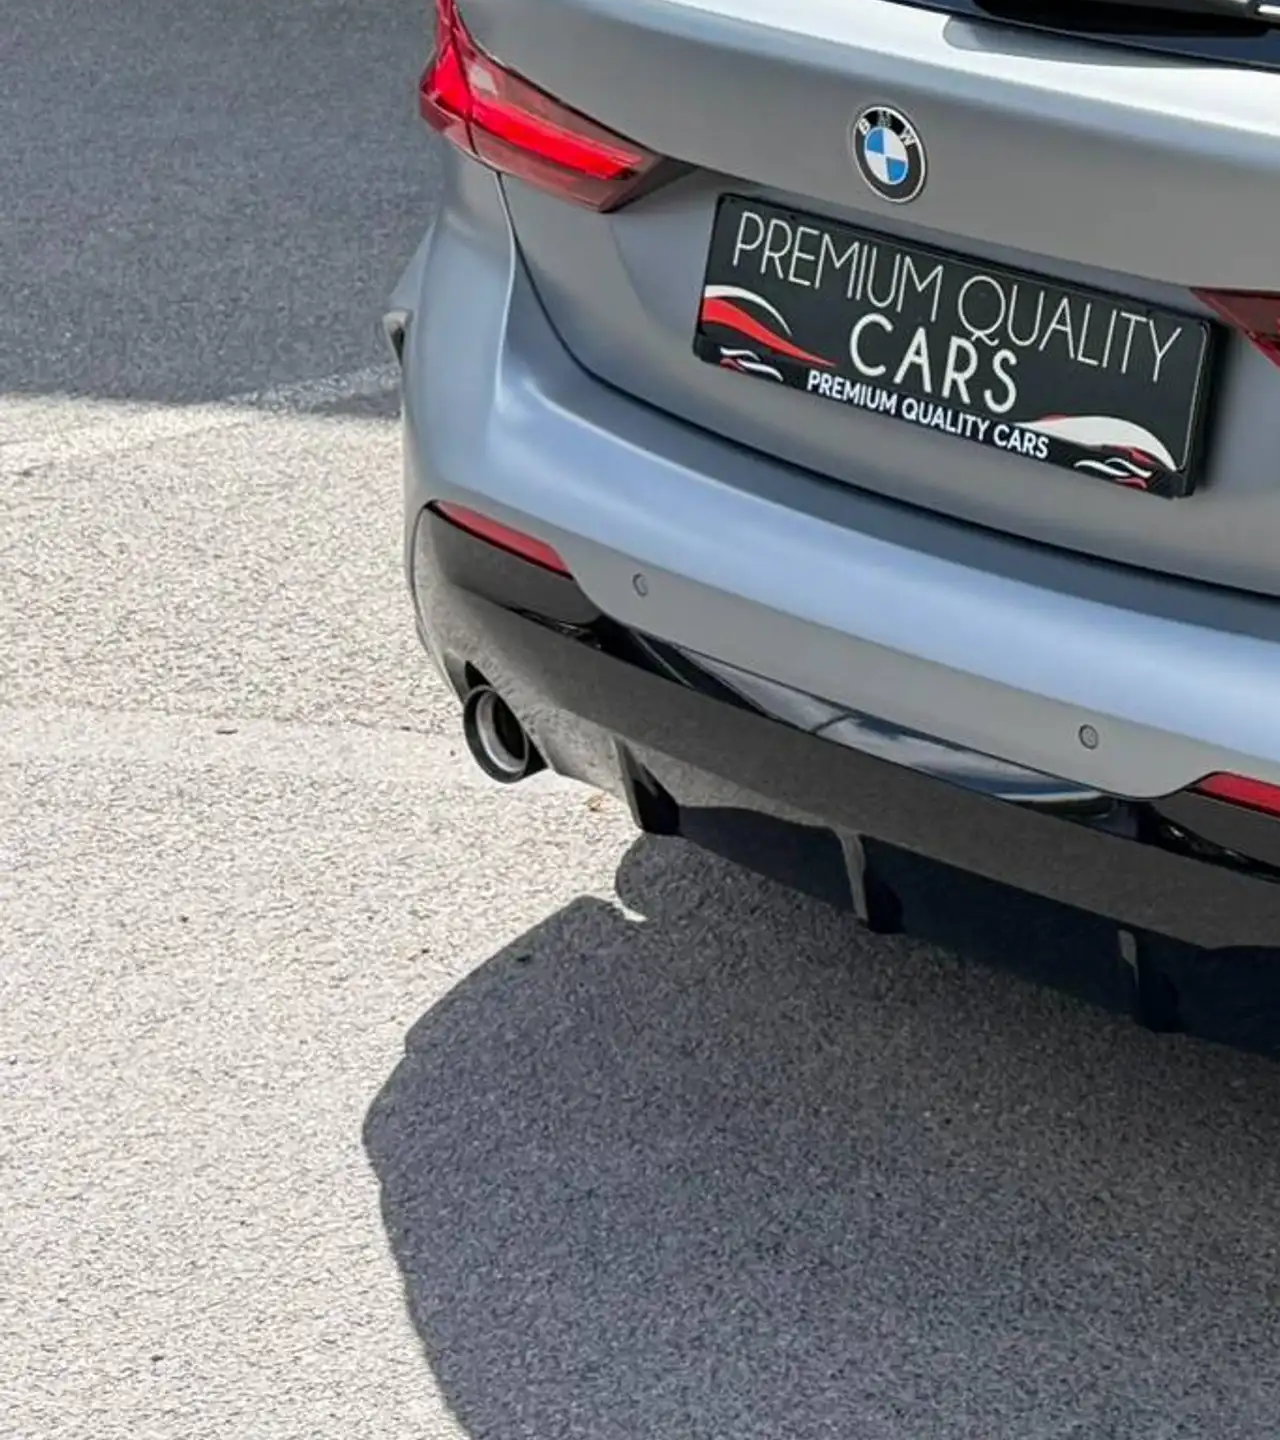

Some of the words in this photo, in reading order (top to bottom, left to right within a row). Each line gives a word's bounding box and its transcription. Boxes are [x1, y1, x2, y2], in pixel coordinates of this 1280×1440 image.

[858, 110, 917, 147] BMW
[732, 210, 945, 324] PREMIUM
[958, 275, 1184, 384] QUALITY
[848, 313, 1020, 414] CARS
[806, 369, 898, 417] PREMIUM
[901, 397, 991, 443] QUALITY
[993, 424, 1050, 461] CARS
